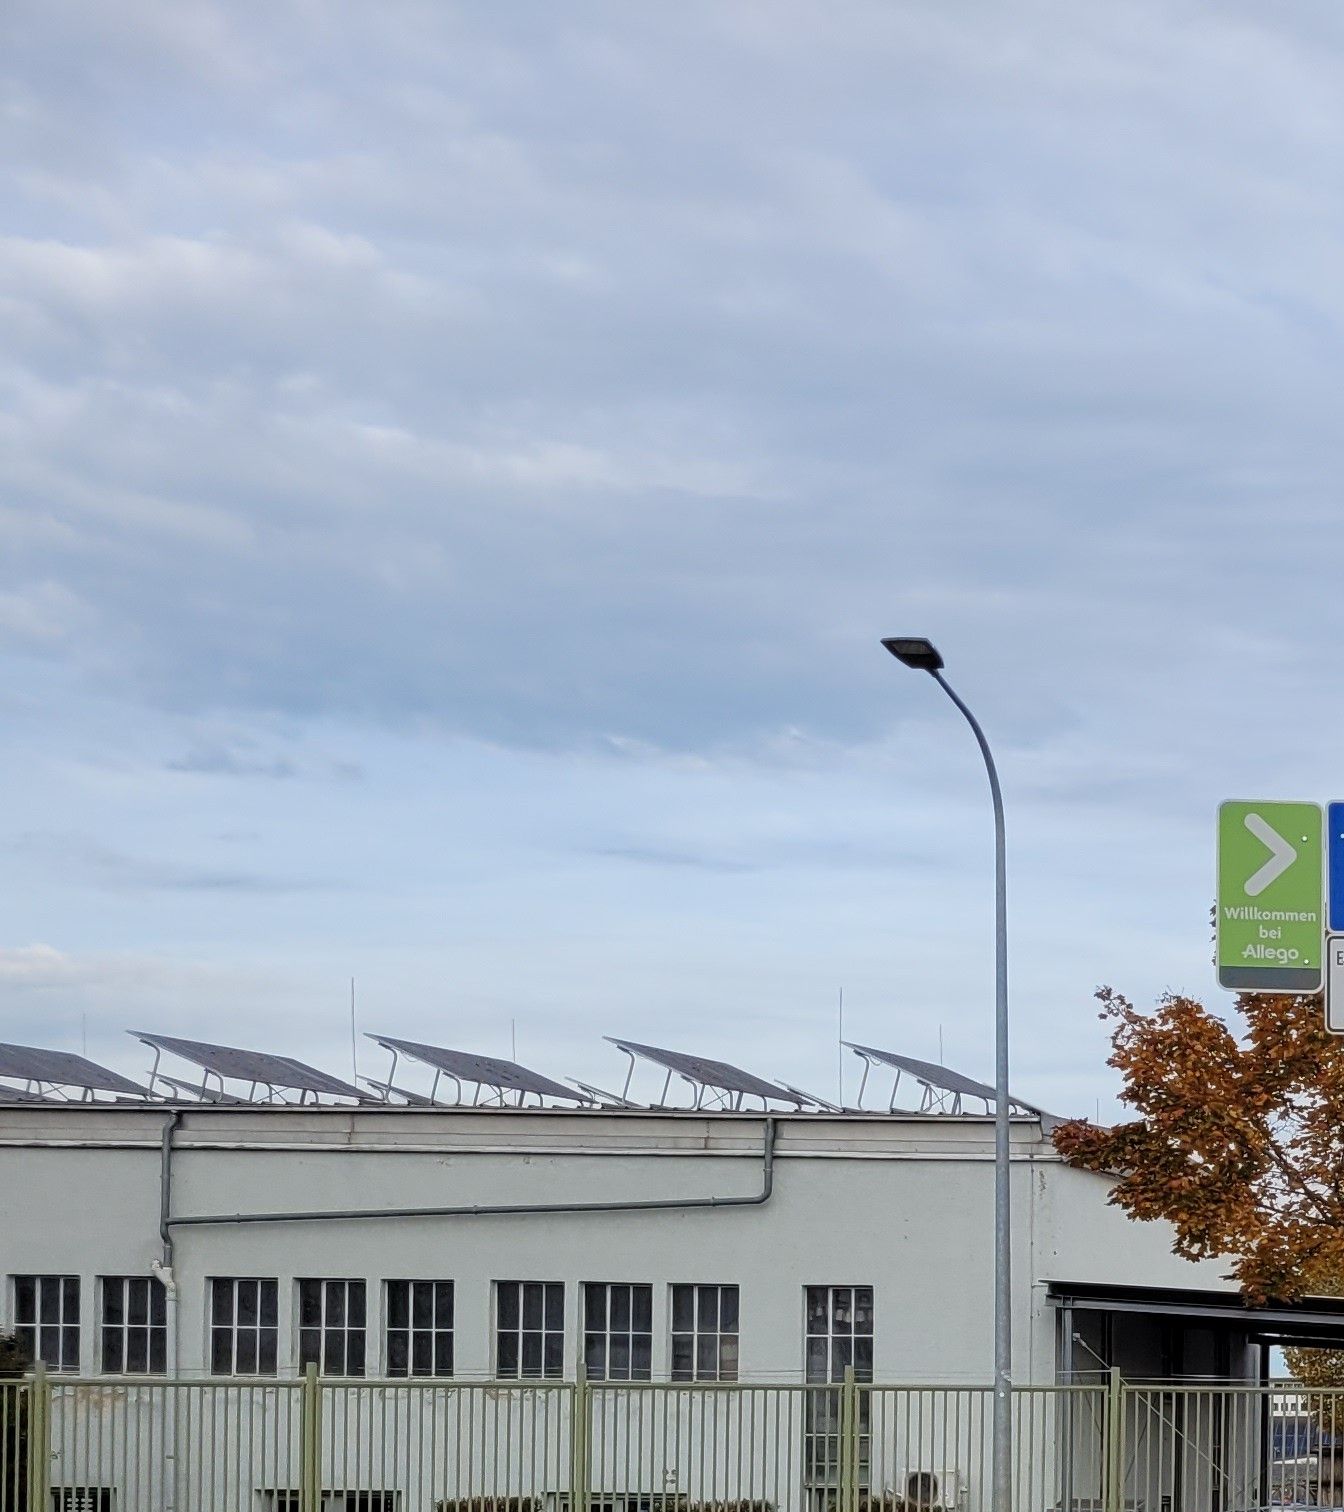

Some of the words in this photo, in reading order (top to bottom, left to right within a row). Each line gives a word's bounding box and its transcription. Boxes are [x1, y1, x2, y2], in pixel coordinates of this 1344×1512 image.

[1224, 907, 1317, 922] Willkommen
[1258, 925, 1282, 939] bei
[1241, 944, 1299, 965] Allego
